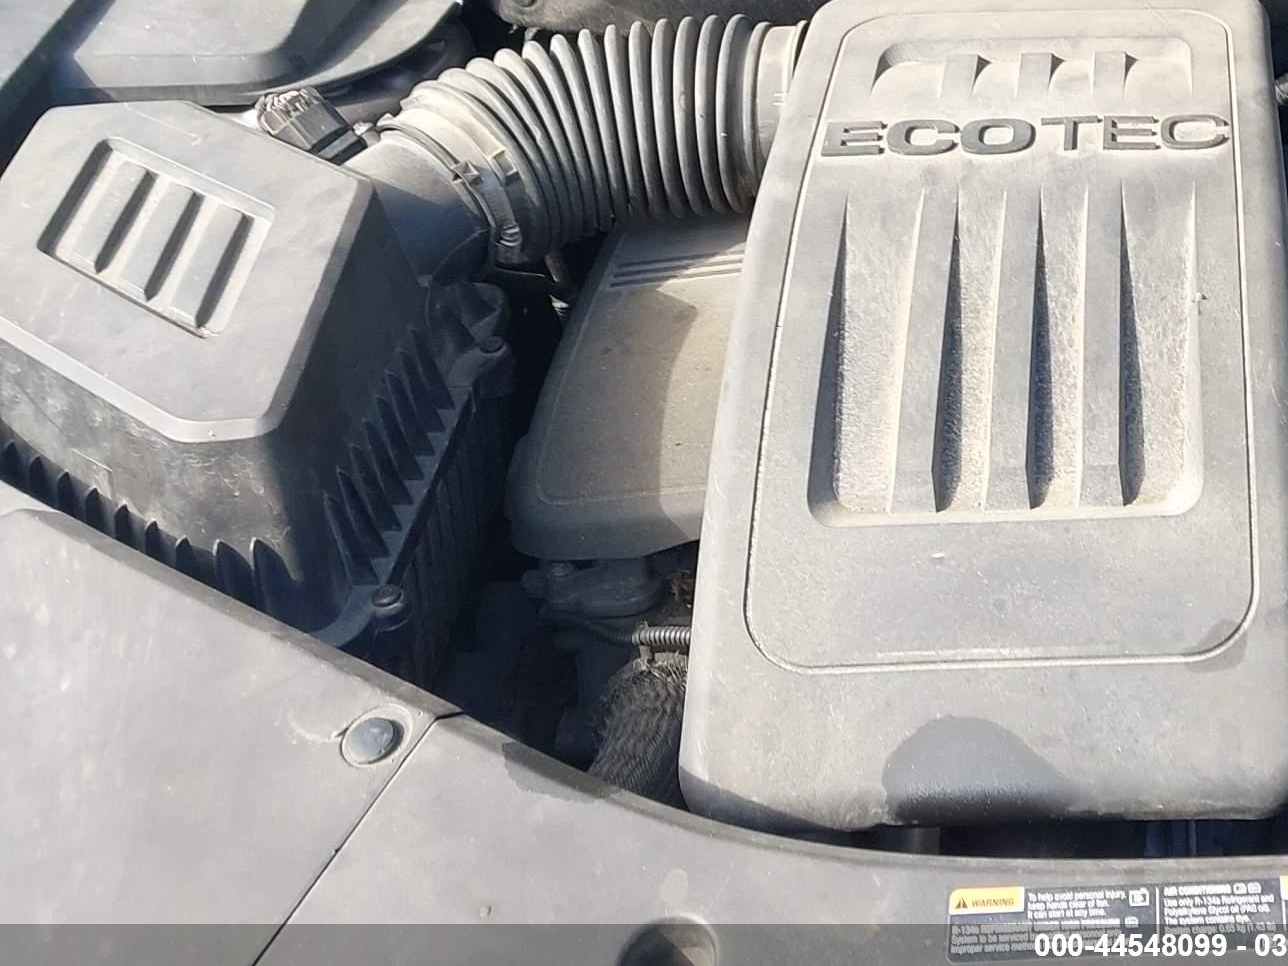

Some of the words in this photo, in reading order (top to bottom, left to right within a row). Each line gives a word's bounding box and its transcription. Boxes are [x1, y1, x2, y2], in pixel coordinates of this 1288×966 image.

[821, 114, 1230, 157] ECOTEC
[1028, 893, 1037, 901] To
[972, 898, 1014, 906] WARNING
